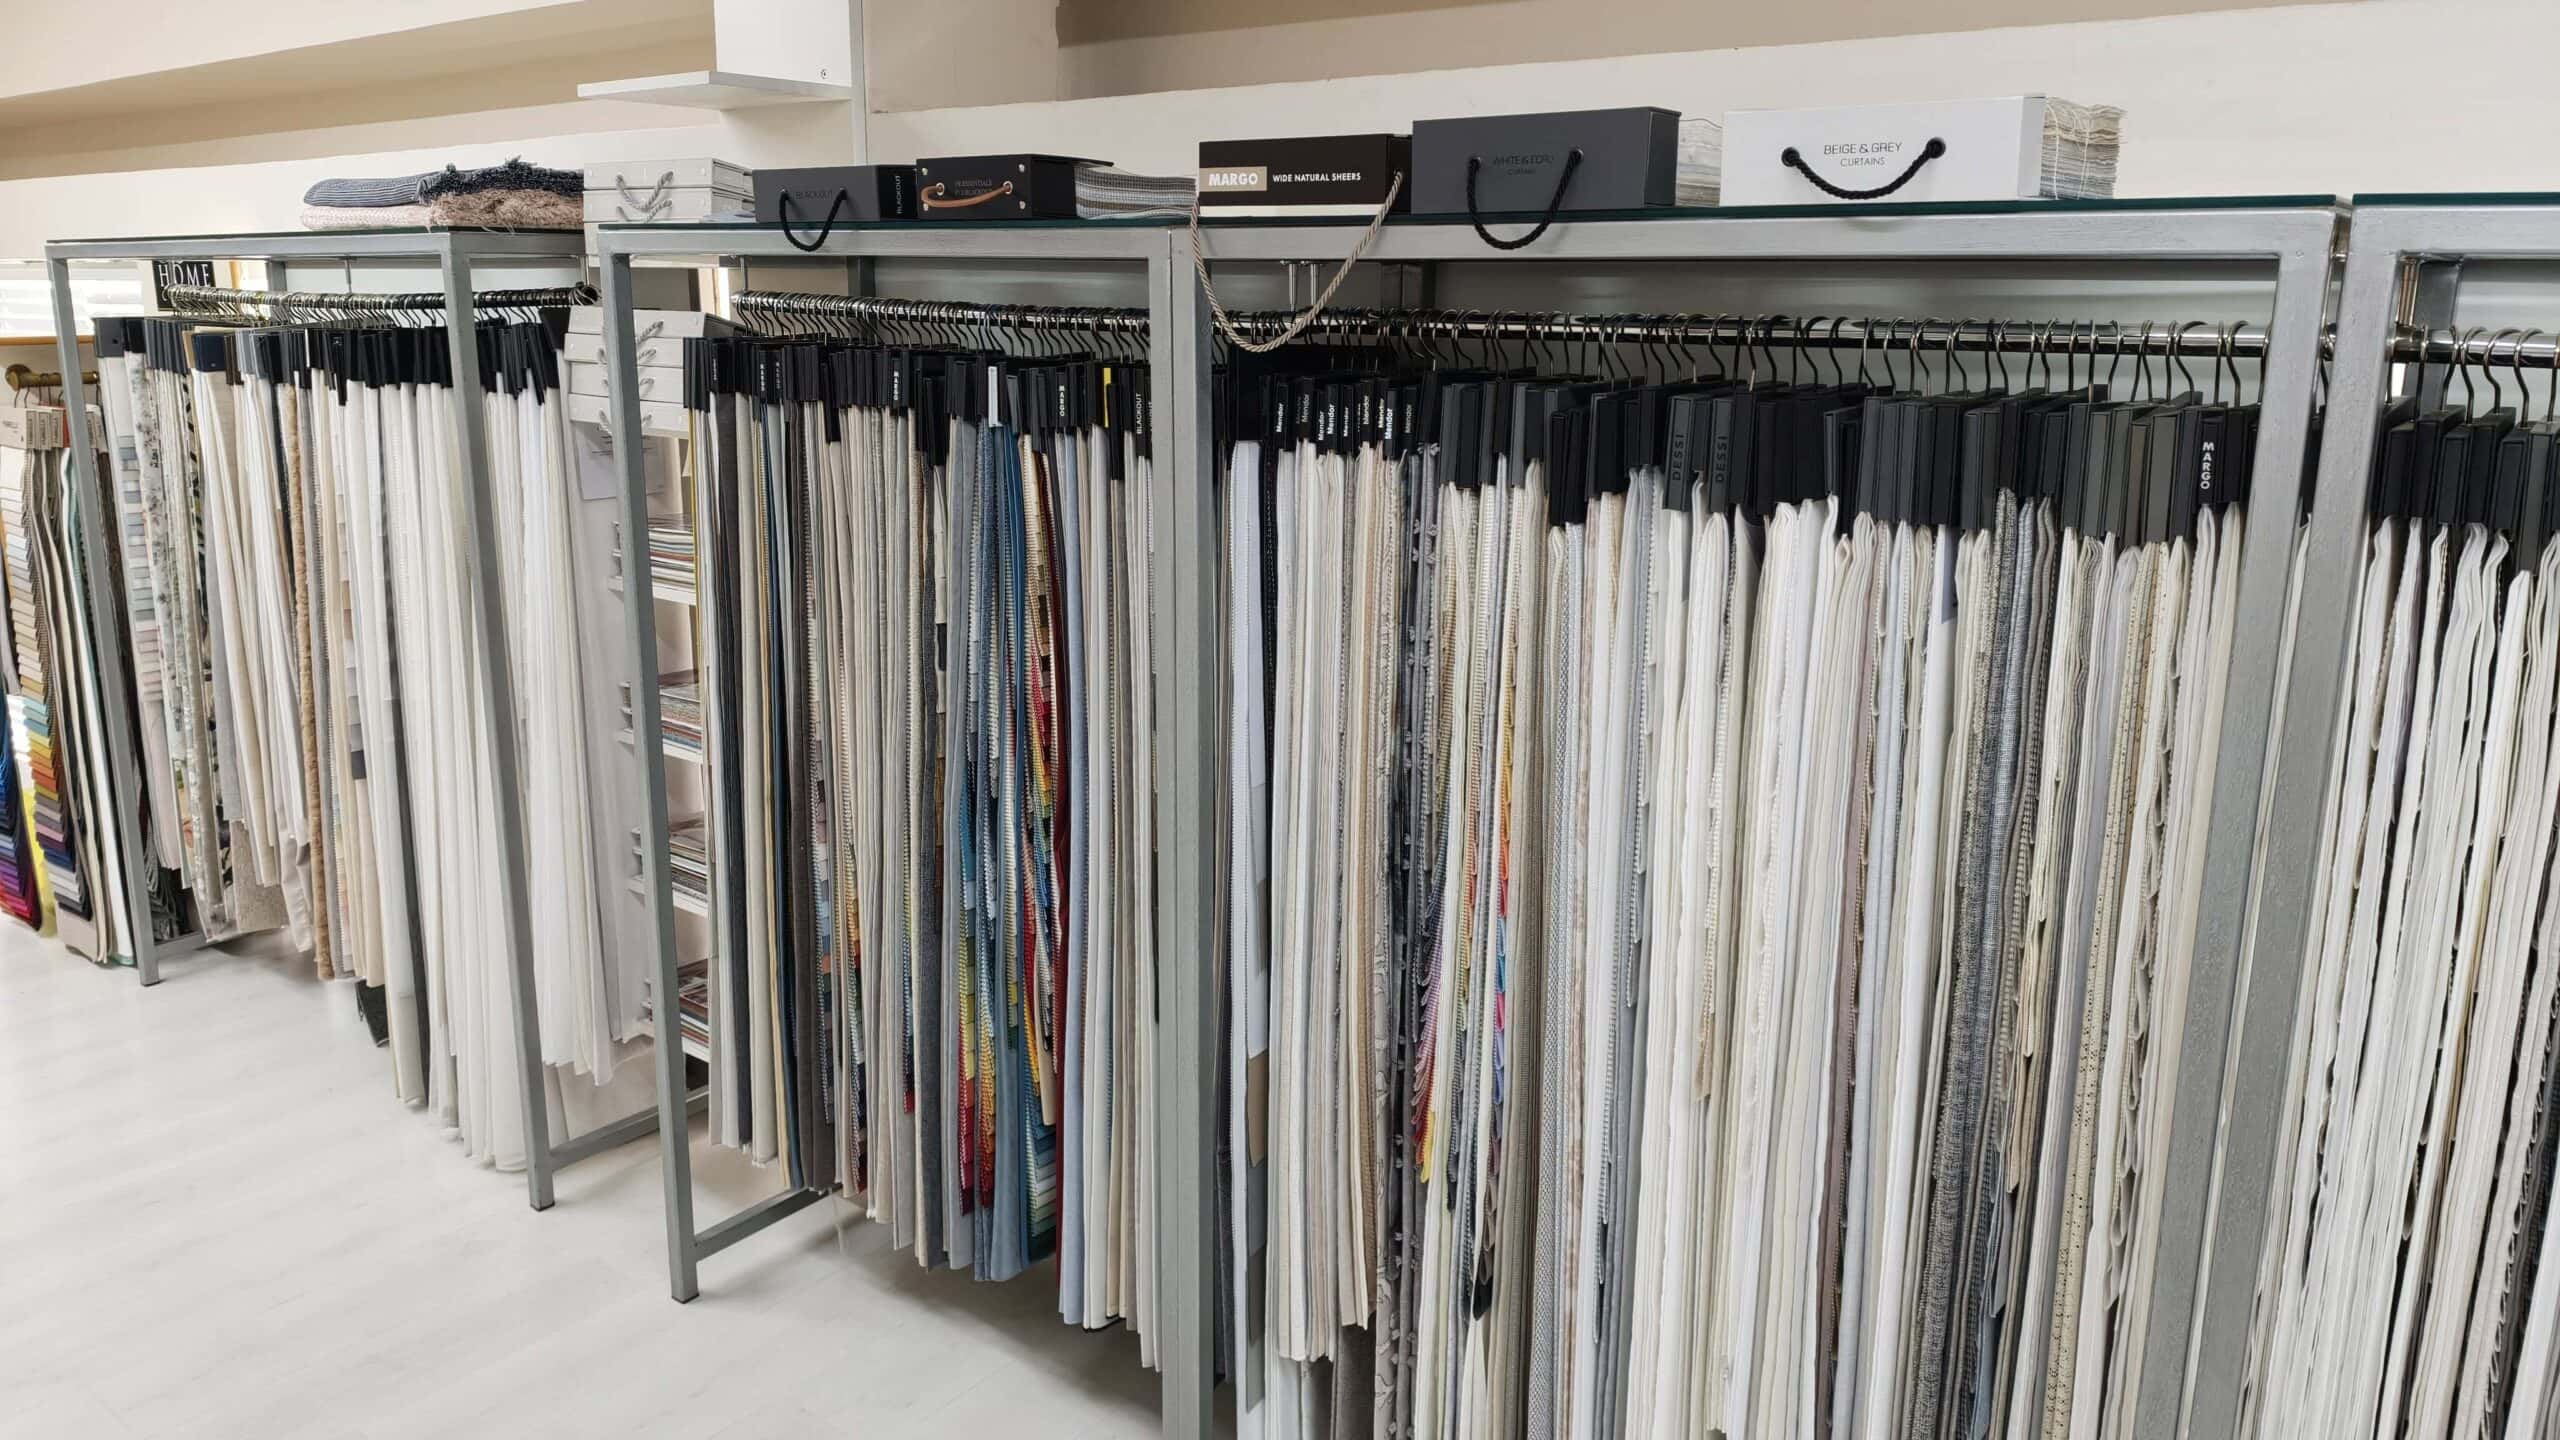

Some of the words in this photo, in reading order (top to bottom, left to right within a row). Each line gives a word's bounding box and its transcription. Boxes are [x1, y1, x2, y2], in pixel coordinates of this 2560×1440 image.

[1823, 143, 1857, 155] BEIGE
[1858, 143, 1869, 154] &
[1871, 141, 1903, 153] GREY
[1839, 156, 1886, 167] CURTAINS
[1208, 172, 1259, 187] MARGO
[1272, 173, 1294, 183] WIDE
[1294, 173, 1330, 182] NATURAL
[1331, 172, 1362, 181] SHEERS
[895, 175, 904, 214] BLACKOUT
[158, 263, 211, 288] HOME
[1135, 393, 1143, 435] BLACKOUT
[1276, 403, 1284, 433] Mendor
[1302, 393, 1310, 423] Mendor
[1327, 403, 1335, 435] Mendor
[1362, 395, 1370, 425] Mendor
[1384, 408, 1393, 439] Mendor
[1672, 434, 1685, 481] DESSI
[1715, 435, 1729, 482] DESSI
[2200, 441, 2214, 490] MARGO
